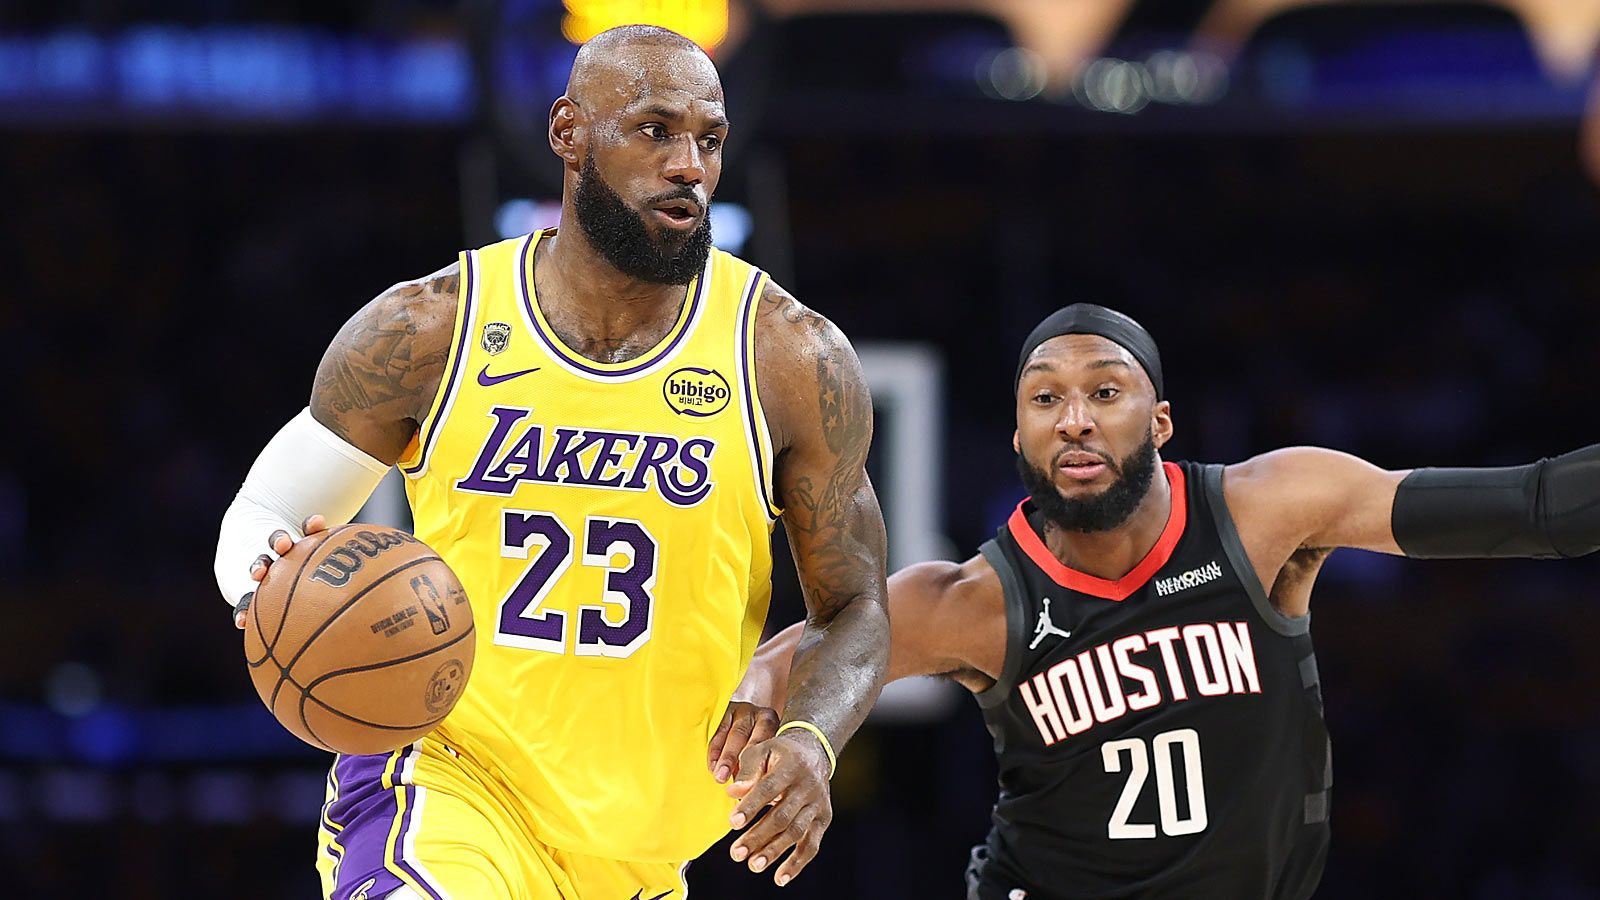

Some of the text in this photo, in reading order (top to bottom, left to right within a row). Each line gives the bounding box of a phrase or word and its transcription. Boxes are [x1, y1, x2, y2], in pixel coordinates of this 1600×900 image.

[669, 379, 727, 403] bibigo
[678, 396, 703, 406] 비비고
[453, 404, 719, 509] LAKERS
[493, 508, 660, 659] 23
[1155, 560, 1221, 590] MEMORIAL
[1156, 566, 1222, 596] HERMANN
[1018, 621, 1263, 748] HOUSTON
[1101, 728, 1208, 839] 20
